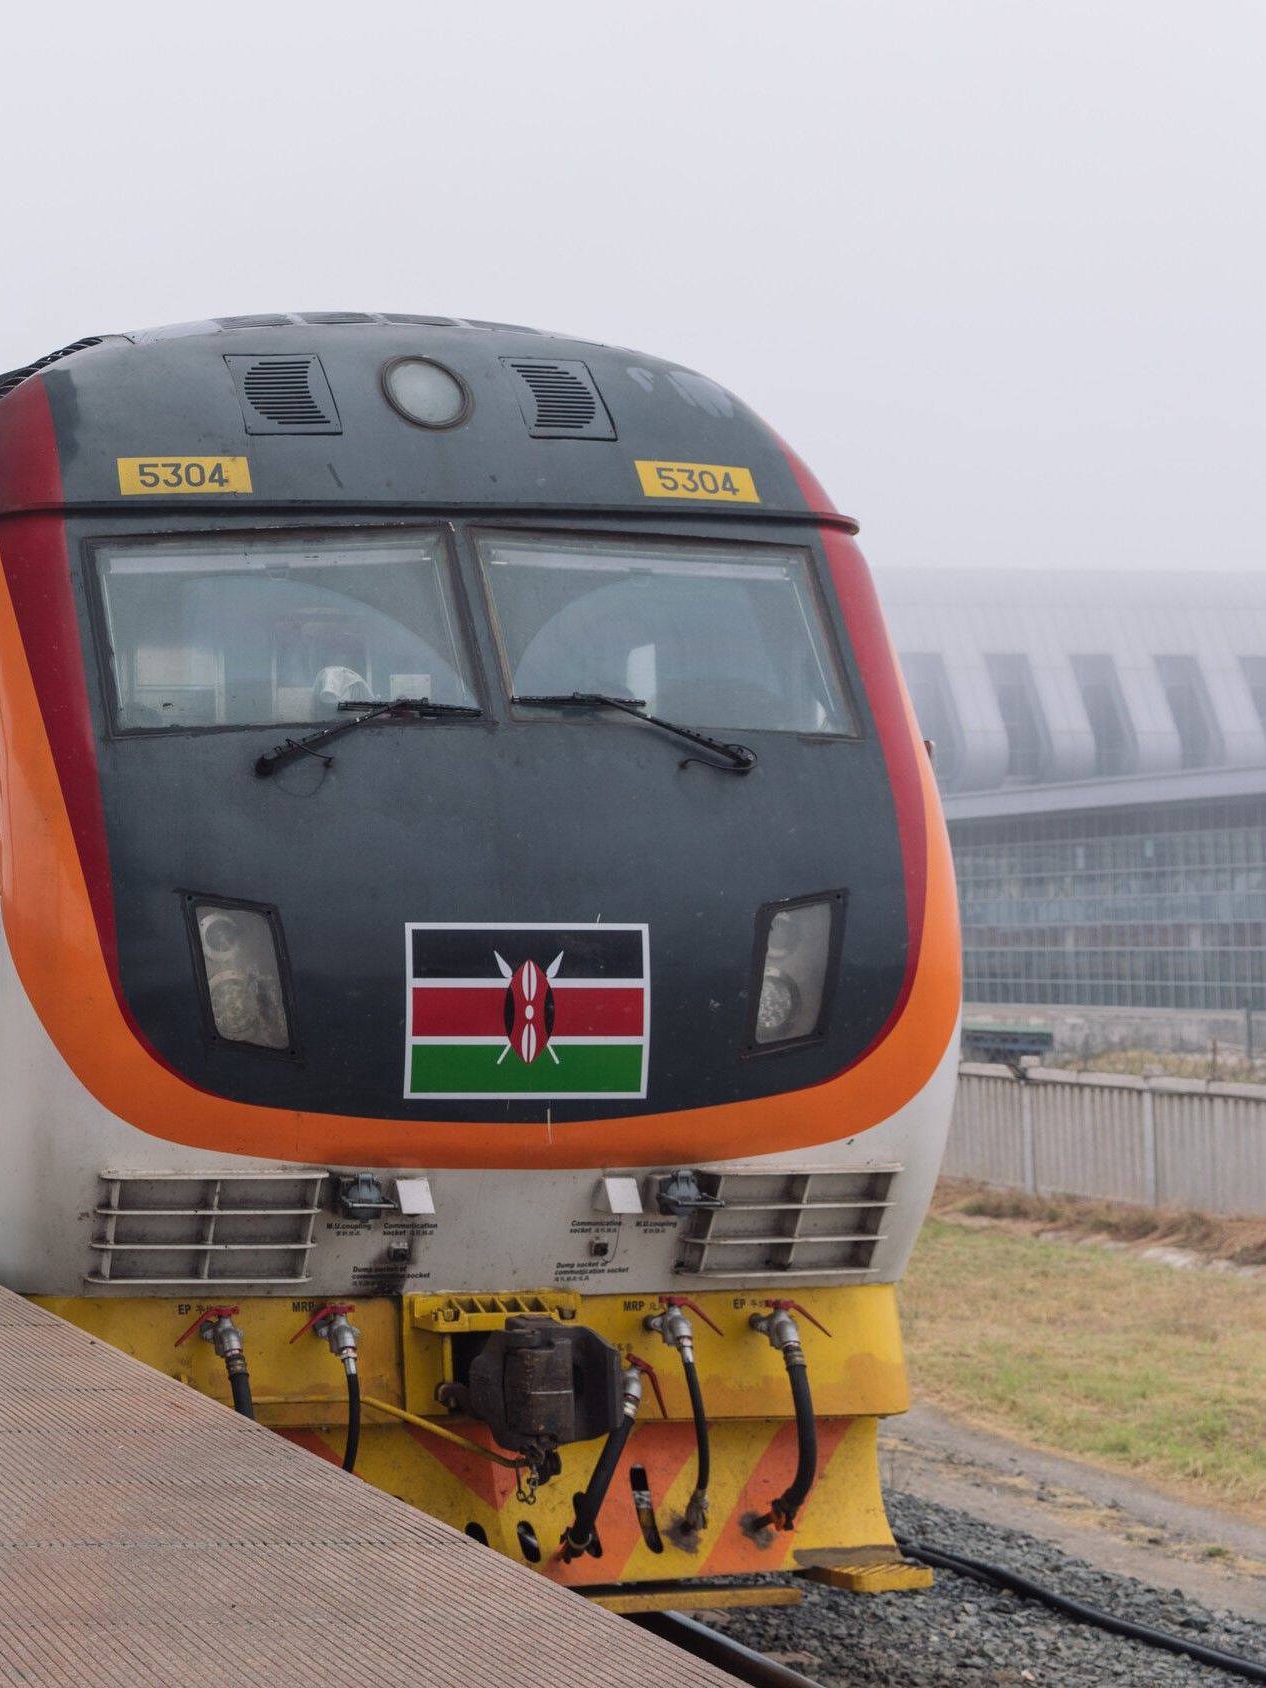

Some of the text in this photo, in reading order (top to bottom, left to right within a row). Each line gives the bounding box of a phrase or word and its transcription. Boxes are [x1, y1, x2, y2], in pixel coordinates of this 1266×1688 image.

[138, 463, 228, 488] 5304
[657, 467, 740, 495] 5304
[178, 1304, 191, 1315] EP
[292, 1301, 315, 1313] MRP
[623, 1300, 645, 1312] MRP
[733, 1299, 746, 1309] EP
